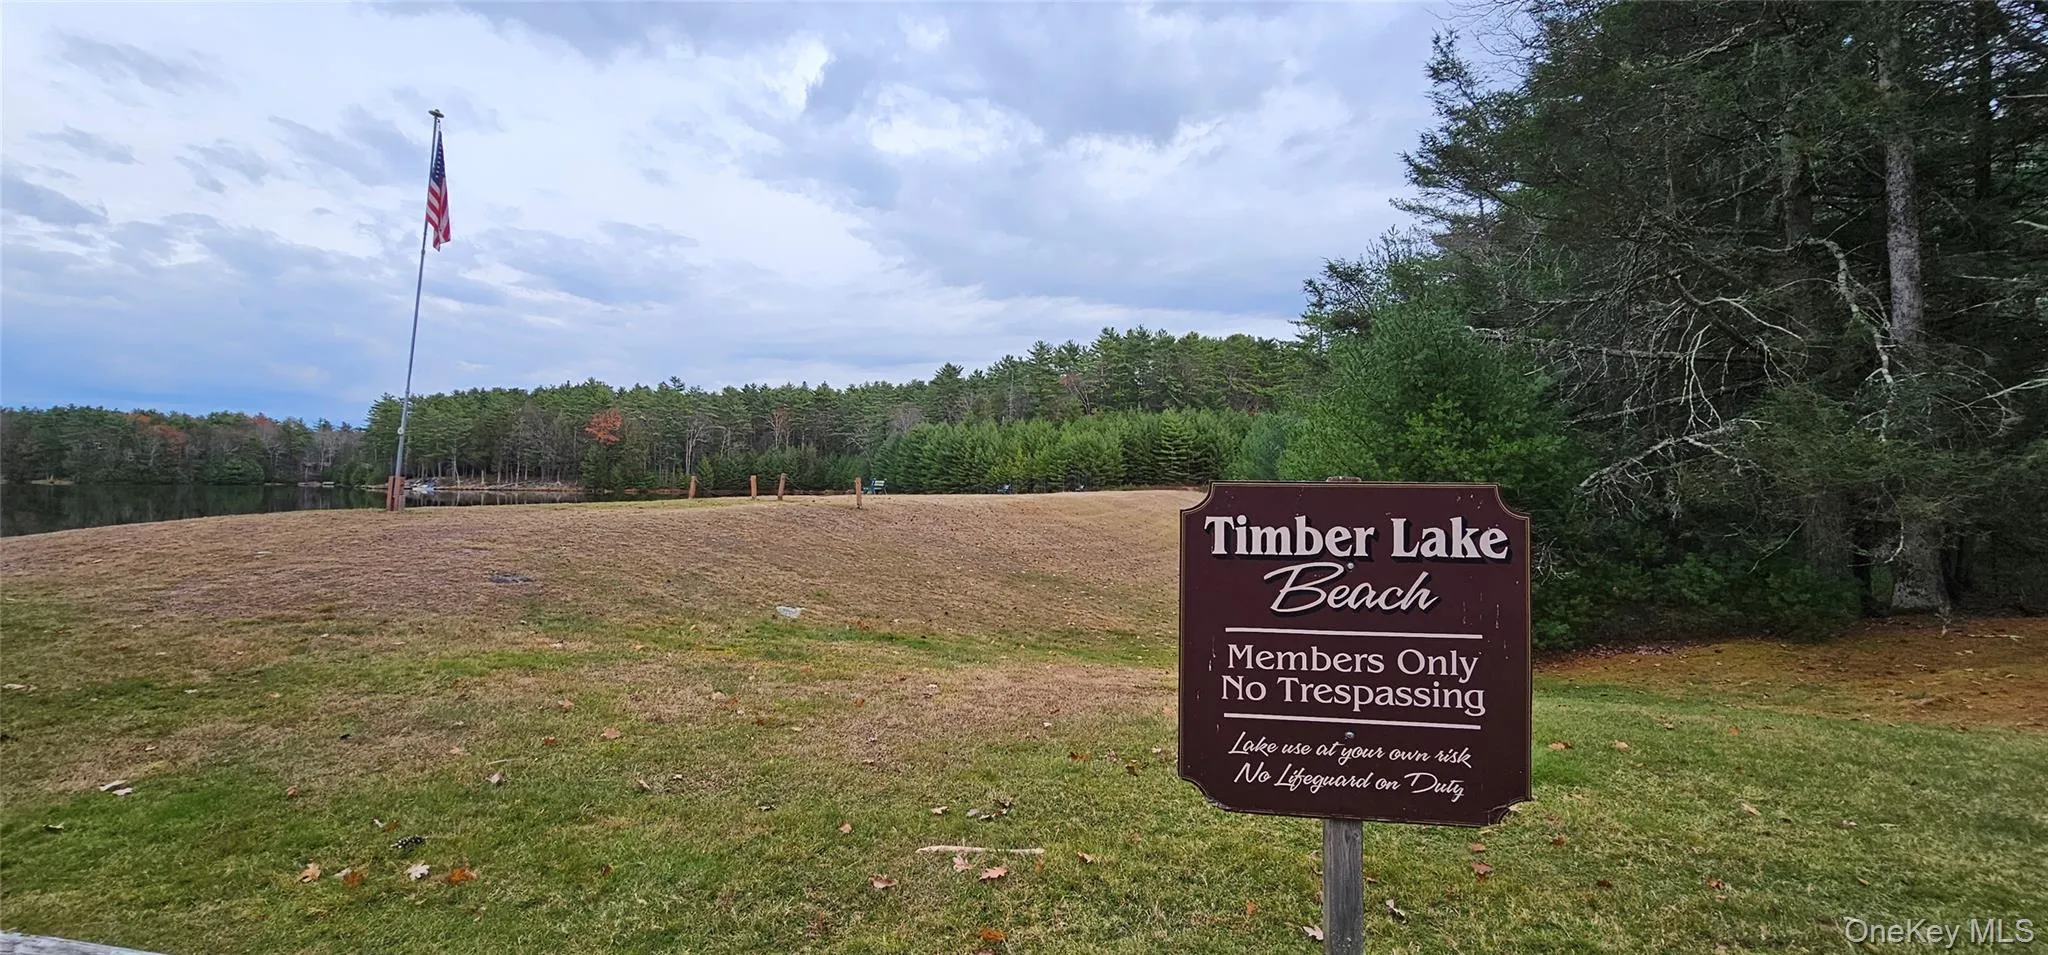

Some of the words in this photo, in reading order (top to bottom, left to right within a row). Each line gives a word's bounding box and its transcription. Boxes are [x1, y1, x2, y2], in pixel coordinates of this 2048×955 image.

[1204, 515, 1375, 557] Timber
[1390, 517, 1508, 559] Lake
[1264, 562, 1439, 613] Beach
[1228, 644, 1384, 673] Members
[1397, 649, 1478, 682] Only
[1221, 675, 1266, 701] No
[1277, 677, 1486, 716] Trespassing
[1228, 732, 1278, 755] Lake
[1282, 743, 1312, 756] use
[1316, 741, 1340, 756] at
[1341, 746, 1386, 765] your
[1389, 748, 1429, 762] own
[1435, 748, 1472, 768] risk
[1234, 762, 1271, 784] No
[1274, 764, 1370, 792] Lifeguard
[1376, 777, 1401, 790] on
[1404, 772, 1464, 802] Duty
